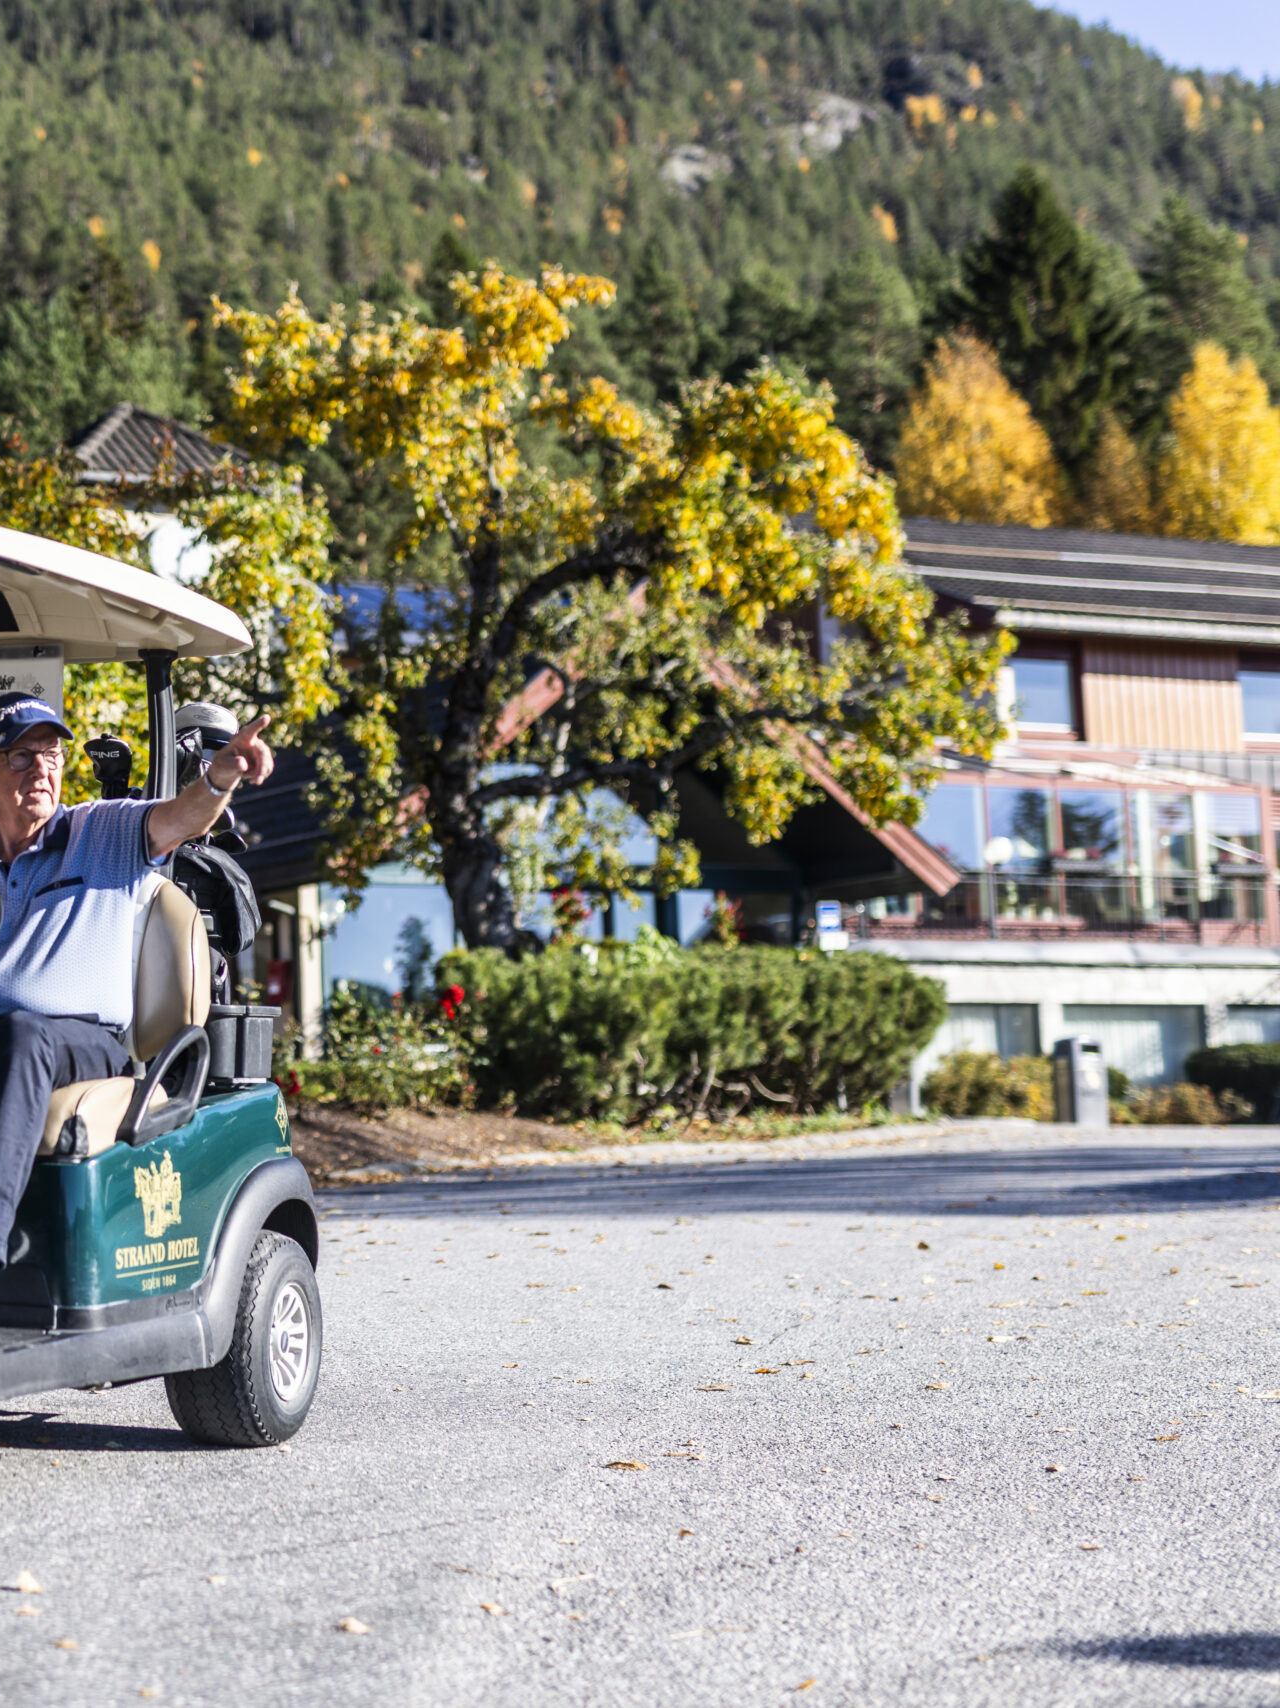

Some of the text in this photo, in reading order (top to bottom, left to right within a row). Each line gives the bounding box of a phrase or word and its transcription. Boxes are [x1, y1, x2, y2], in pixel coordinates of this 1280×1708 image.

[90, 750, 120, 759] PING
[115, 1237, 200, 1270] STRAAND HOTEL
